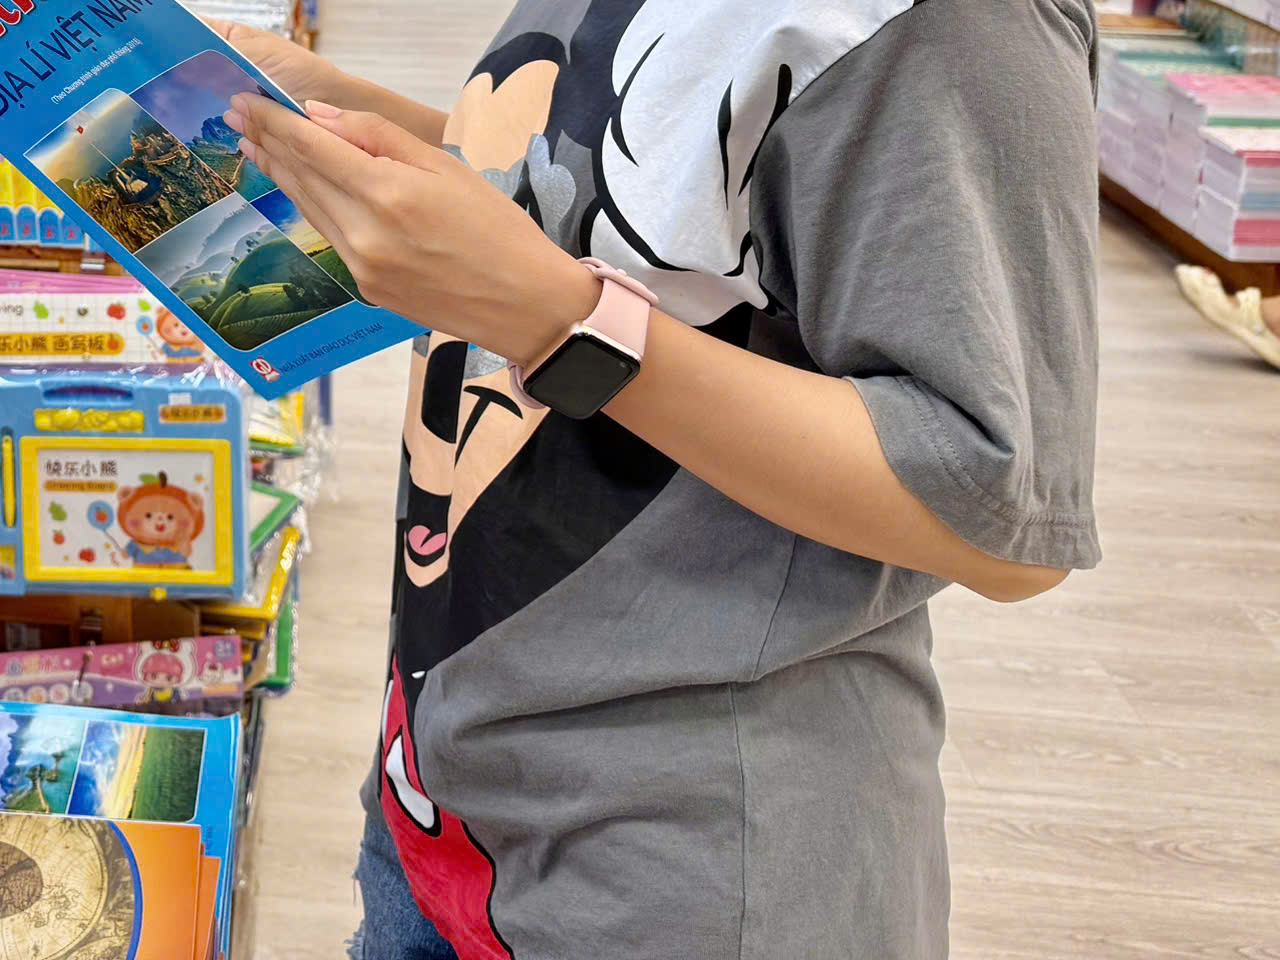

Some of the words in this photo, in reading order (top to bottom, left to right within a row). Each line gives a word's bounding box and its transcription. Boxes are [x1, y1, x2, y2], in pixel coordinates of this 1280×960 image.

[19, 40, 57, 81] LÍ
[39, 10, 102, 61] VIỆT
[46, 459, 117, 478] 快乐小熊
